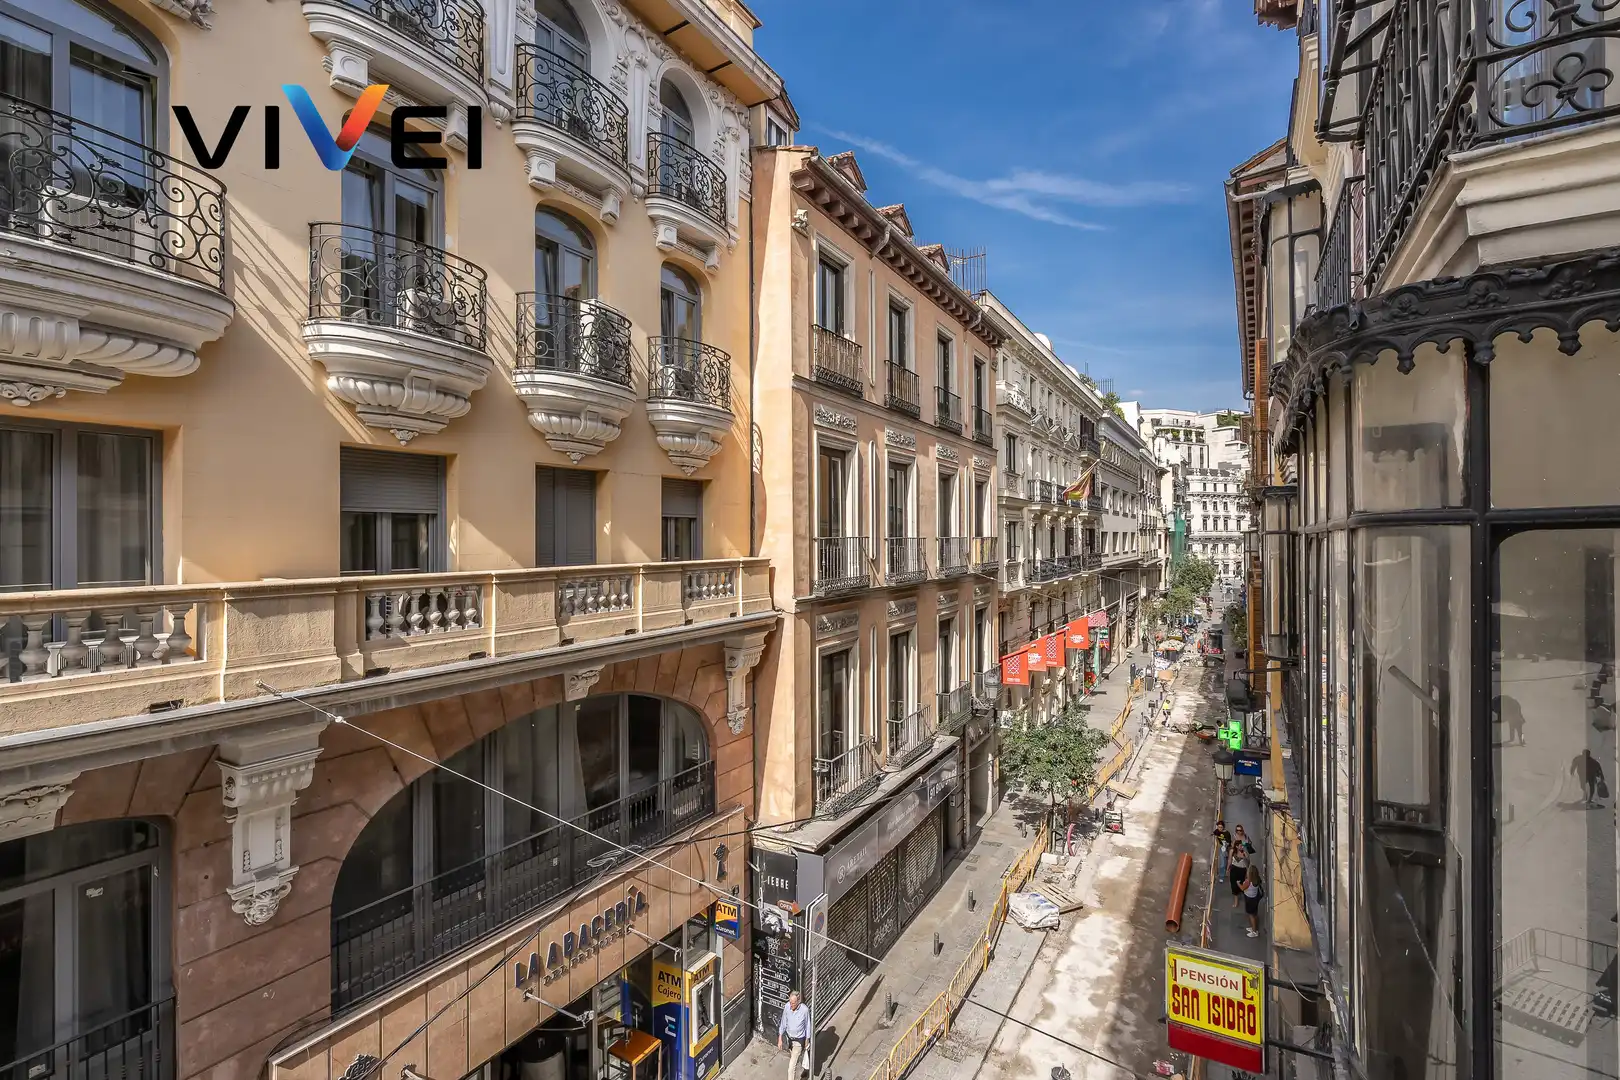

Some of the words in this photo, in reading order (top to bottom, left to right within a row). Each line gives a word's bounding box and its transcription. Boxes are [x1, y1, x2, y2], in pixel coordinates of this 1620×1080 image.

[1224, 731, 1238, 739] 12
[716, 903, 737, 917] ATM
[780, 902, 793, 911] OPEN
[515, 952, 539, 988] LA
[546, 884, 645, 969] ABACERÍA
[658, 970, 681, 988] ATM
[694, 964, 710, 983] ATM
[1180, 967, 1239, 991] PENSIÓN
[658, 984, 681, 1000] Cajero
[1172, 983, 1200, 1021] SAN
[1207, 992, 1257, 1036] ISIDRO
